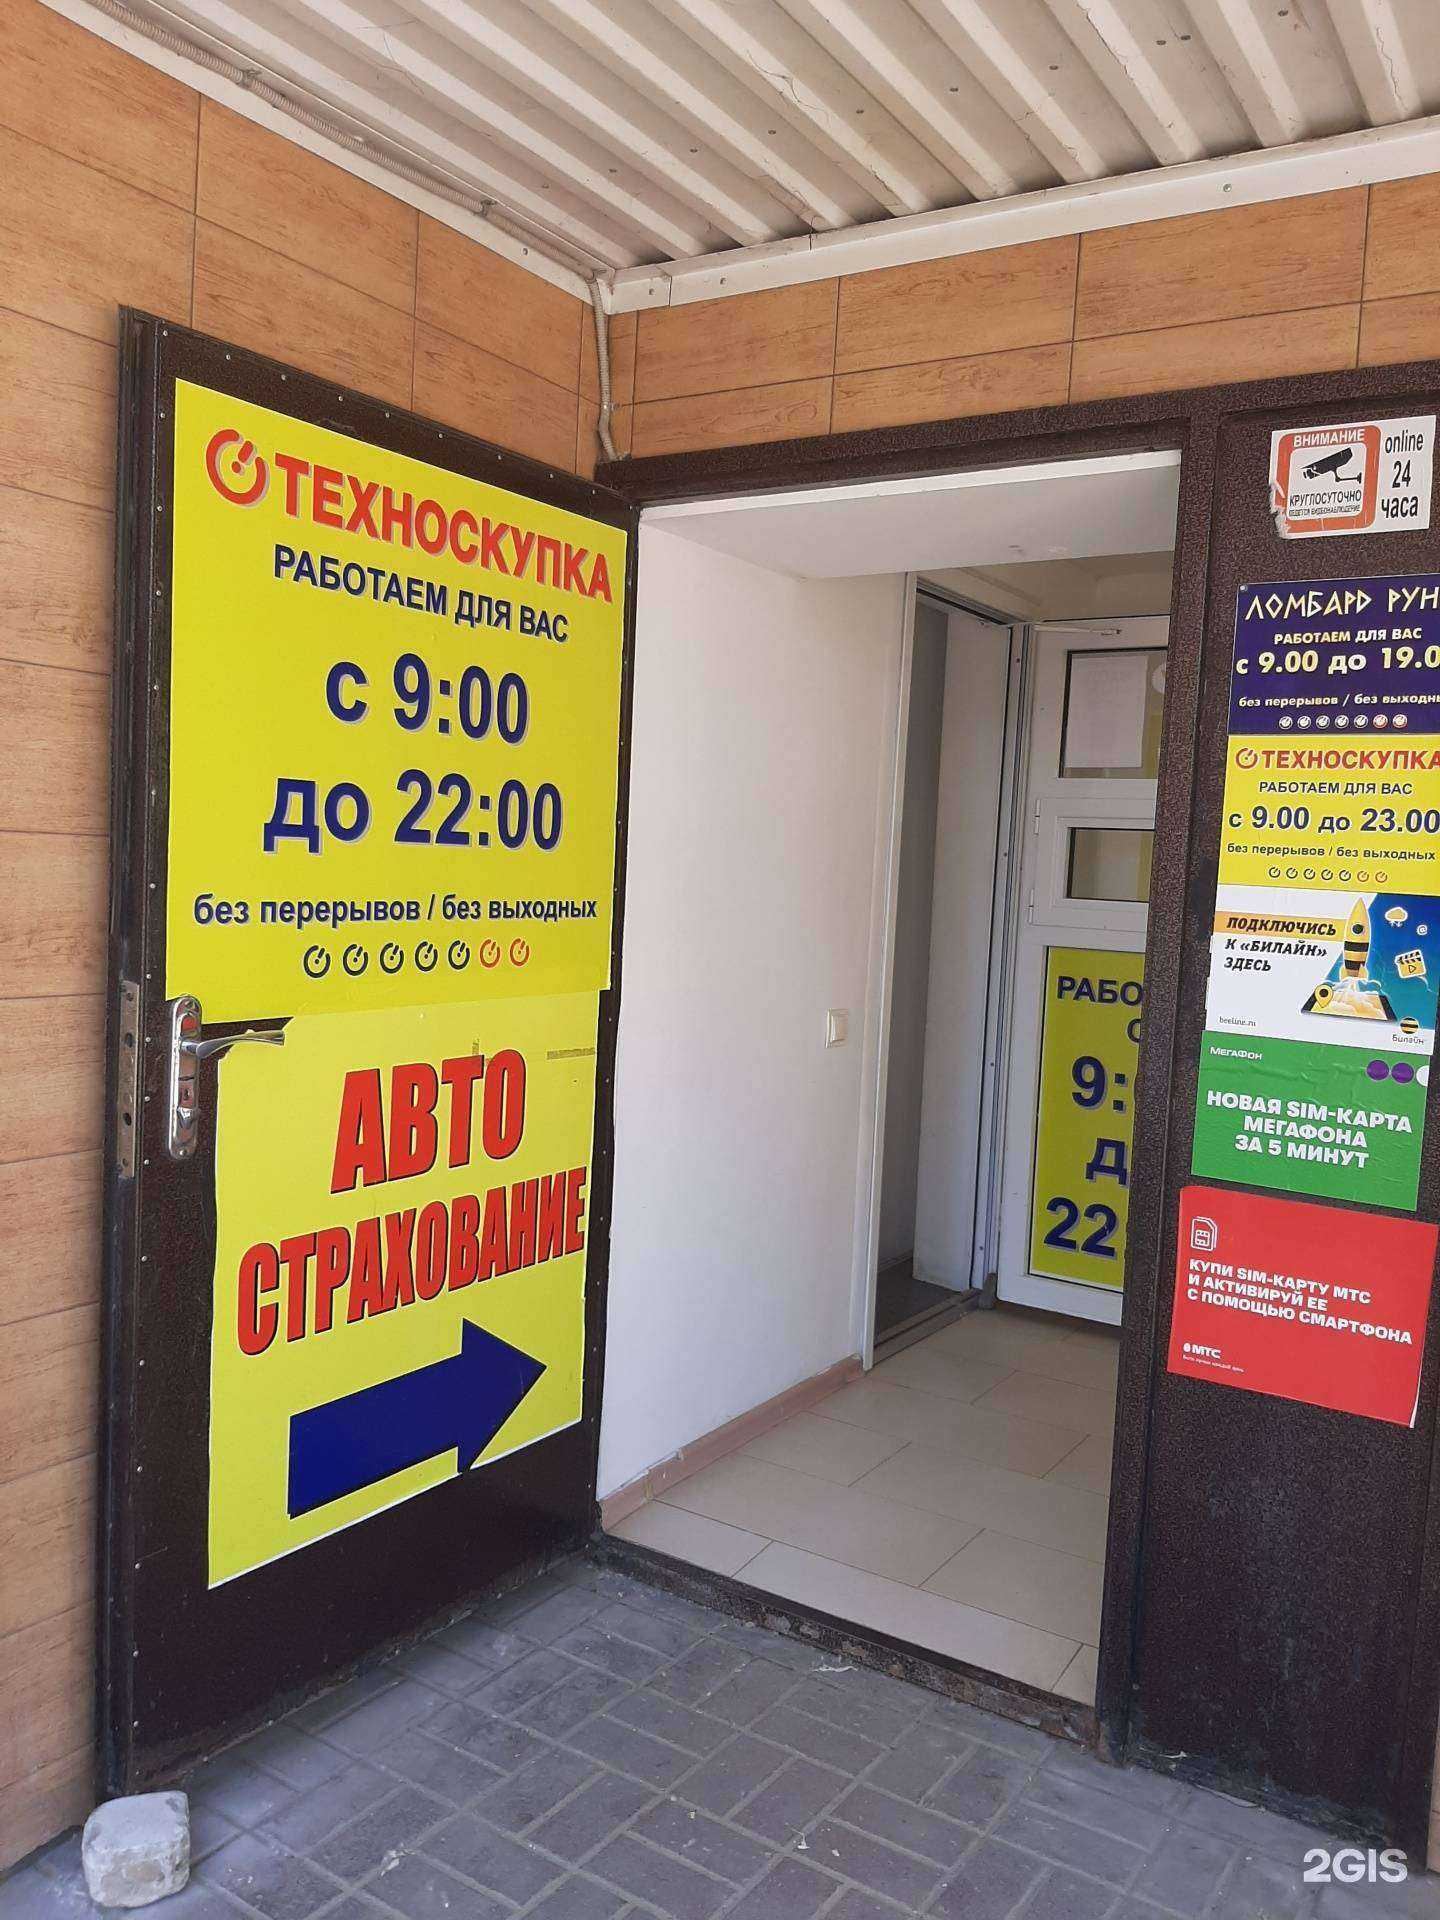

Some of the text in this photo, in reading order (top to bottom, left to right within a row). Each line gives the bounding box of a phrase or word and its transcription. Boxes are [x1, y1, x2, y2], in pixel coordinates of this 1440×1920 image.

[1293, 428, 1365, 447] ВНИМАНИЕ
[1385, 430, 1424, 453] online
[1392, 460, 1411, 488] 24
[1289, 489, 1362, 507] КРУГЛОСУТОЧНО
[1381, 496, 1419, 518] часа
[275, 453, 613, 603] ТЕХНОСКУПКА
[273, 544, 569, 643] РАБОТАЕМ ДЛЯ ВАС
[1245, 589, 1372, 620] ЛОМБАРД
[1274, 628, 1422, 644] РАБОТАЕМ ДЛЯ ВАС
[1258, 650, 1319, 673] 9.00
[1328, 654, 1367, 675] до
[393, 653, 529, 745] 9:00
[1239, 696, 1261, 707] без
[1265, 695, 1338, 709] перерывов
[1354, 693, 1378, 705] без
[1262, 750, 1440, 769] ТЕХНОСКУПКА
[1259, 782, 1413, 795] РАБОТАЕМ ДЛЯ ВАС
[394, 769, 563, 850] 22:00
[1251, 806, 1309, 829] 9.00
[1318, 815, 1351, 833] до
[1360, 808, 1440, 833] 23.00
[1227, 843, 1248, 854] без
[1252, 845, 1325, 858] перерывов
[1336, 846, 1359, 858] без
[1363, 849, 1436, 861] выходных
[194, 893, 250, 925] без
[259, 898, 421, 930] перерывов
[441, 895, 482, 920] без
[488, 897, 598, 923] выходных
[1226, 916, 1337, 937] ПОДКЛЮЧИСЬ
[1225, 938, 1328, 958] К «БИЛАЙН»
[1223, 957, 1272, 972] ЗДЕСЬ
[1057, 976, 1143, 1006] РАБО
[1219, 1016, 1257, 1027] beeline.ru
[330, 1049, 527, 1194] АВТО
[1207, 1090, 1413, 1133] НОВАЯ SIM-КАРТА
[1243, 1115, 1368, 1148] МЕГАФОНА
[1235, 1134, 1370, 1168] ЗА 5 МИНУТ
[1044, 1197, 1117, 1259] 22
[236, 1166, 588, 1356] СТРАХОВАНИЕ
[1188, 1274, 1328, 1312] И АКТИВИРУЙ ЕЕ
[1189, 1258, 1372, 1304] КУПИ SIM-КАРТУ МТС
[1187, 1288, 1413, 1345] С ПОМОЩЬЮ СМАРТФОНА
[1192, 1344, 1221, 1359] МТС
